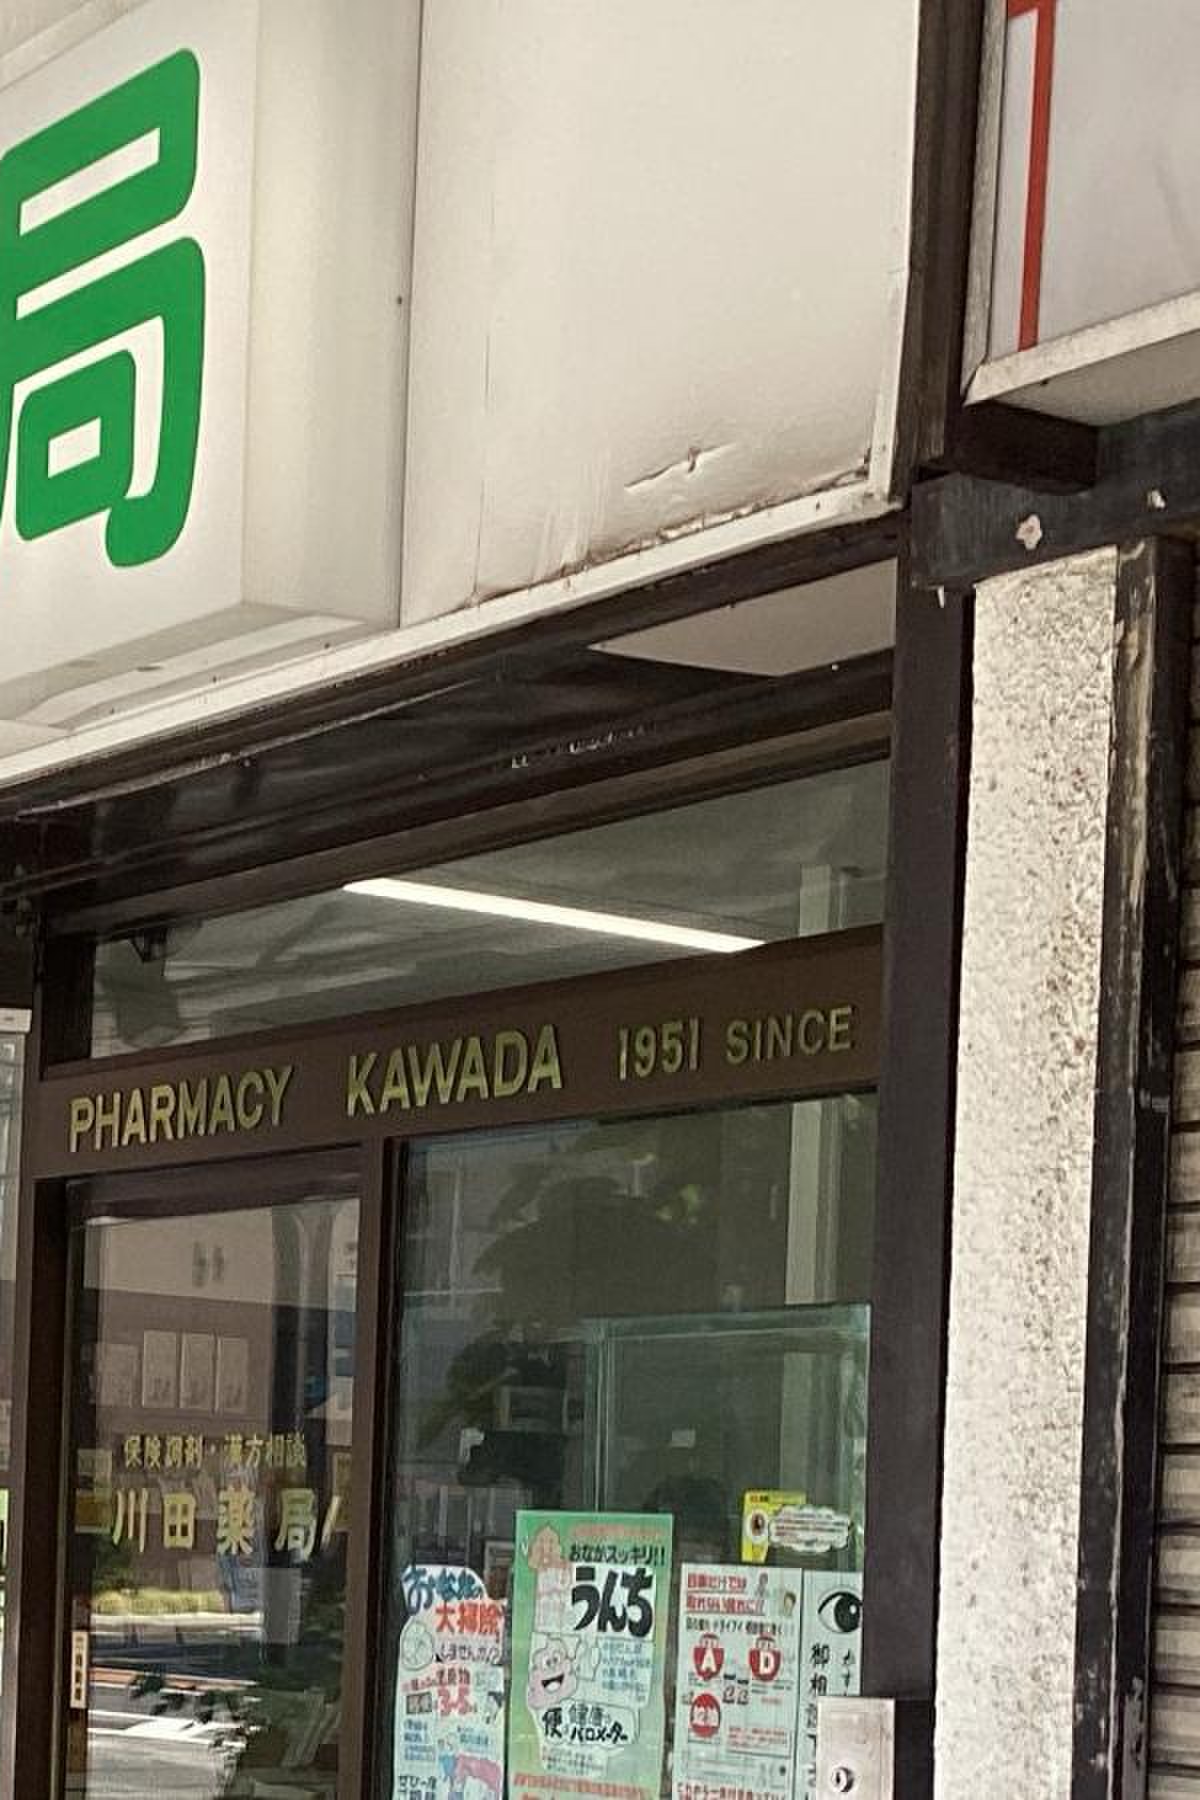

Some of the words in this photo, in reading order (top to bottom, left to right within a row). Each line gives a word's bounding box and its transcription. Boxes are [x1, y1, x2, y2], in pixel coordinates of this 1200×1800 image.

[69, 1065, 292, 1153] PHARMACY
[346, 1024, 563, 1116] KAWADA
[619, 1018, 701, 1081] 1951
[725, 1006, 855, 1065] SINCE
[113, 1484, 318, 1564] 川田薬局
[571, 1566, 654, 1638] うんち
